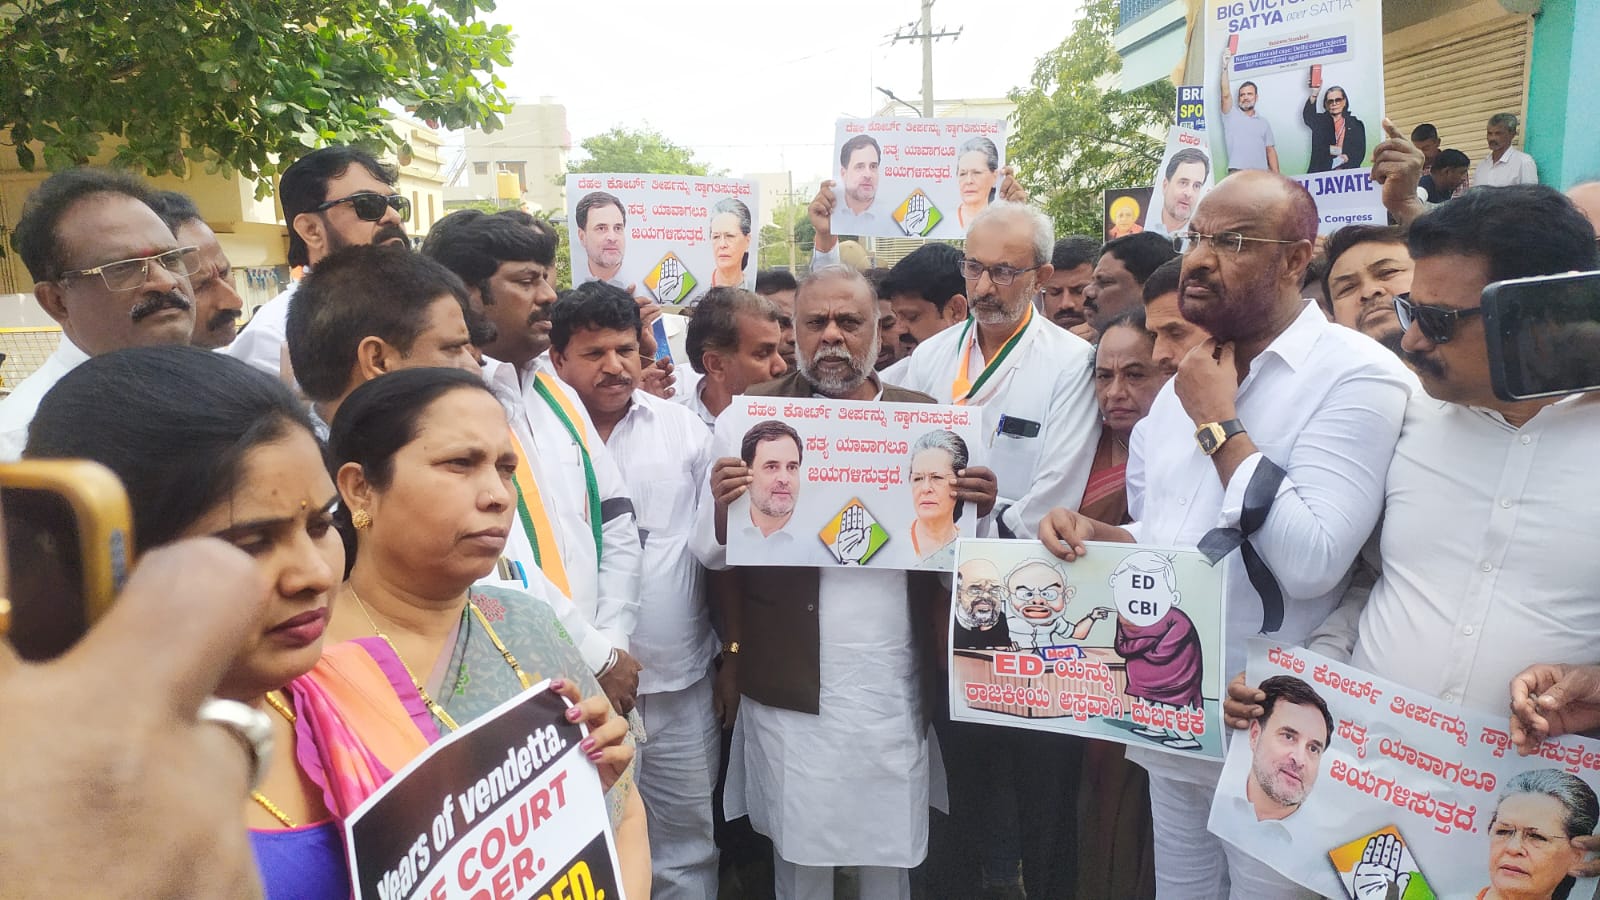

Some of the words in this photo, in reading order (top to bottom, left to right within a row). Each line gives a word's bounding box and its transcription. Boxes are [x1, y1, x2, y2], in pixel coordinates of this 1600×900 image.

[1217, 3, 1244, 20] BIG
[1229, 10, 1283, 33] SATYA
[1180, 104, 1203, 118] SPO
[578, 177, 601, 189] ದೆಹಲಿ
[607, 177, 646, 190] ಕೋರ್ಟ್
[652, 179, 691, 196] ತೀರ್ಪನ್ನು
[695, 182, 752, 199] ಸ್ವಾಗತಿಸುತ್ತೇವೆ.
[1315, 173, 1373, 195] JAYATE
[628, 202, 647, 222] ಸತ್ಯ
[652, 204, 707, 218] ಯಾವಾಗಲೂ
[1324, 214, 1372, 223] Congress
[631, 227, 706, 246] ಜಯಗಳಿಸುತ್ತದೆ.
[748, 403, 777, 417] ದೆಹಲಿ
[783, 403, 832, 419] ಕೋರ್ಟ್
[838, 407, 887, 427] ತೀರ್ಪನ್ನು
[894, 409, 971, 430] ಸ್ವಾಗತಿಸುತ್ತೇವೆ.
[806, 436, 829, 459] ಸತ್ಯ
[836, 438, 908, 455] ಯಾವಾಗಲೂ
[808, 466, 903, 490] ಜಯಗಳಿಸುತ್ತದೆ.
[1132, 575, 1155, 590] ED
[1128, 600, 1157, 616] CBI
[995, 654, 1043, 676] ED
[1055, 658, 1115, 694] ಯನ್ನು
[965, 683, 1050, 707] ರಾಜಕೀಯ
[1131, 701, 1205, 734] ದುರ್ಬಳಕೆ
[1267, 647, 1306, 674] ದೆಹಲಿ
[1312, 664, 1383, 705] ಕೋರ್ಟ್
[1389, 695, 1469, 747] ತೀರ್ಪನ್ನು
[1336, 718, 1370, 758] ಸತ್ಯ
[1379, 737, 1497, 793] ಯಾವಾಗಲೂ
[432, 794, 456, 852] of
[458, 724, 567, 825] vendetta.
[1329, 758, 1478, 835] ಜಯಗಳಿಸುತ್ತದೆ.
[457, 769, 568, 892] COURT
